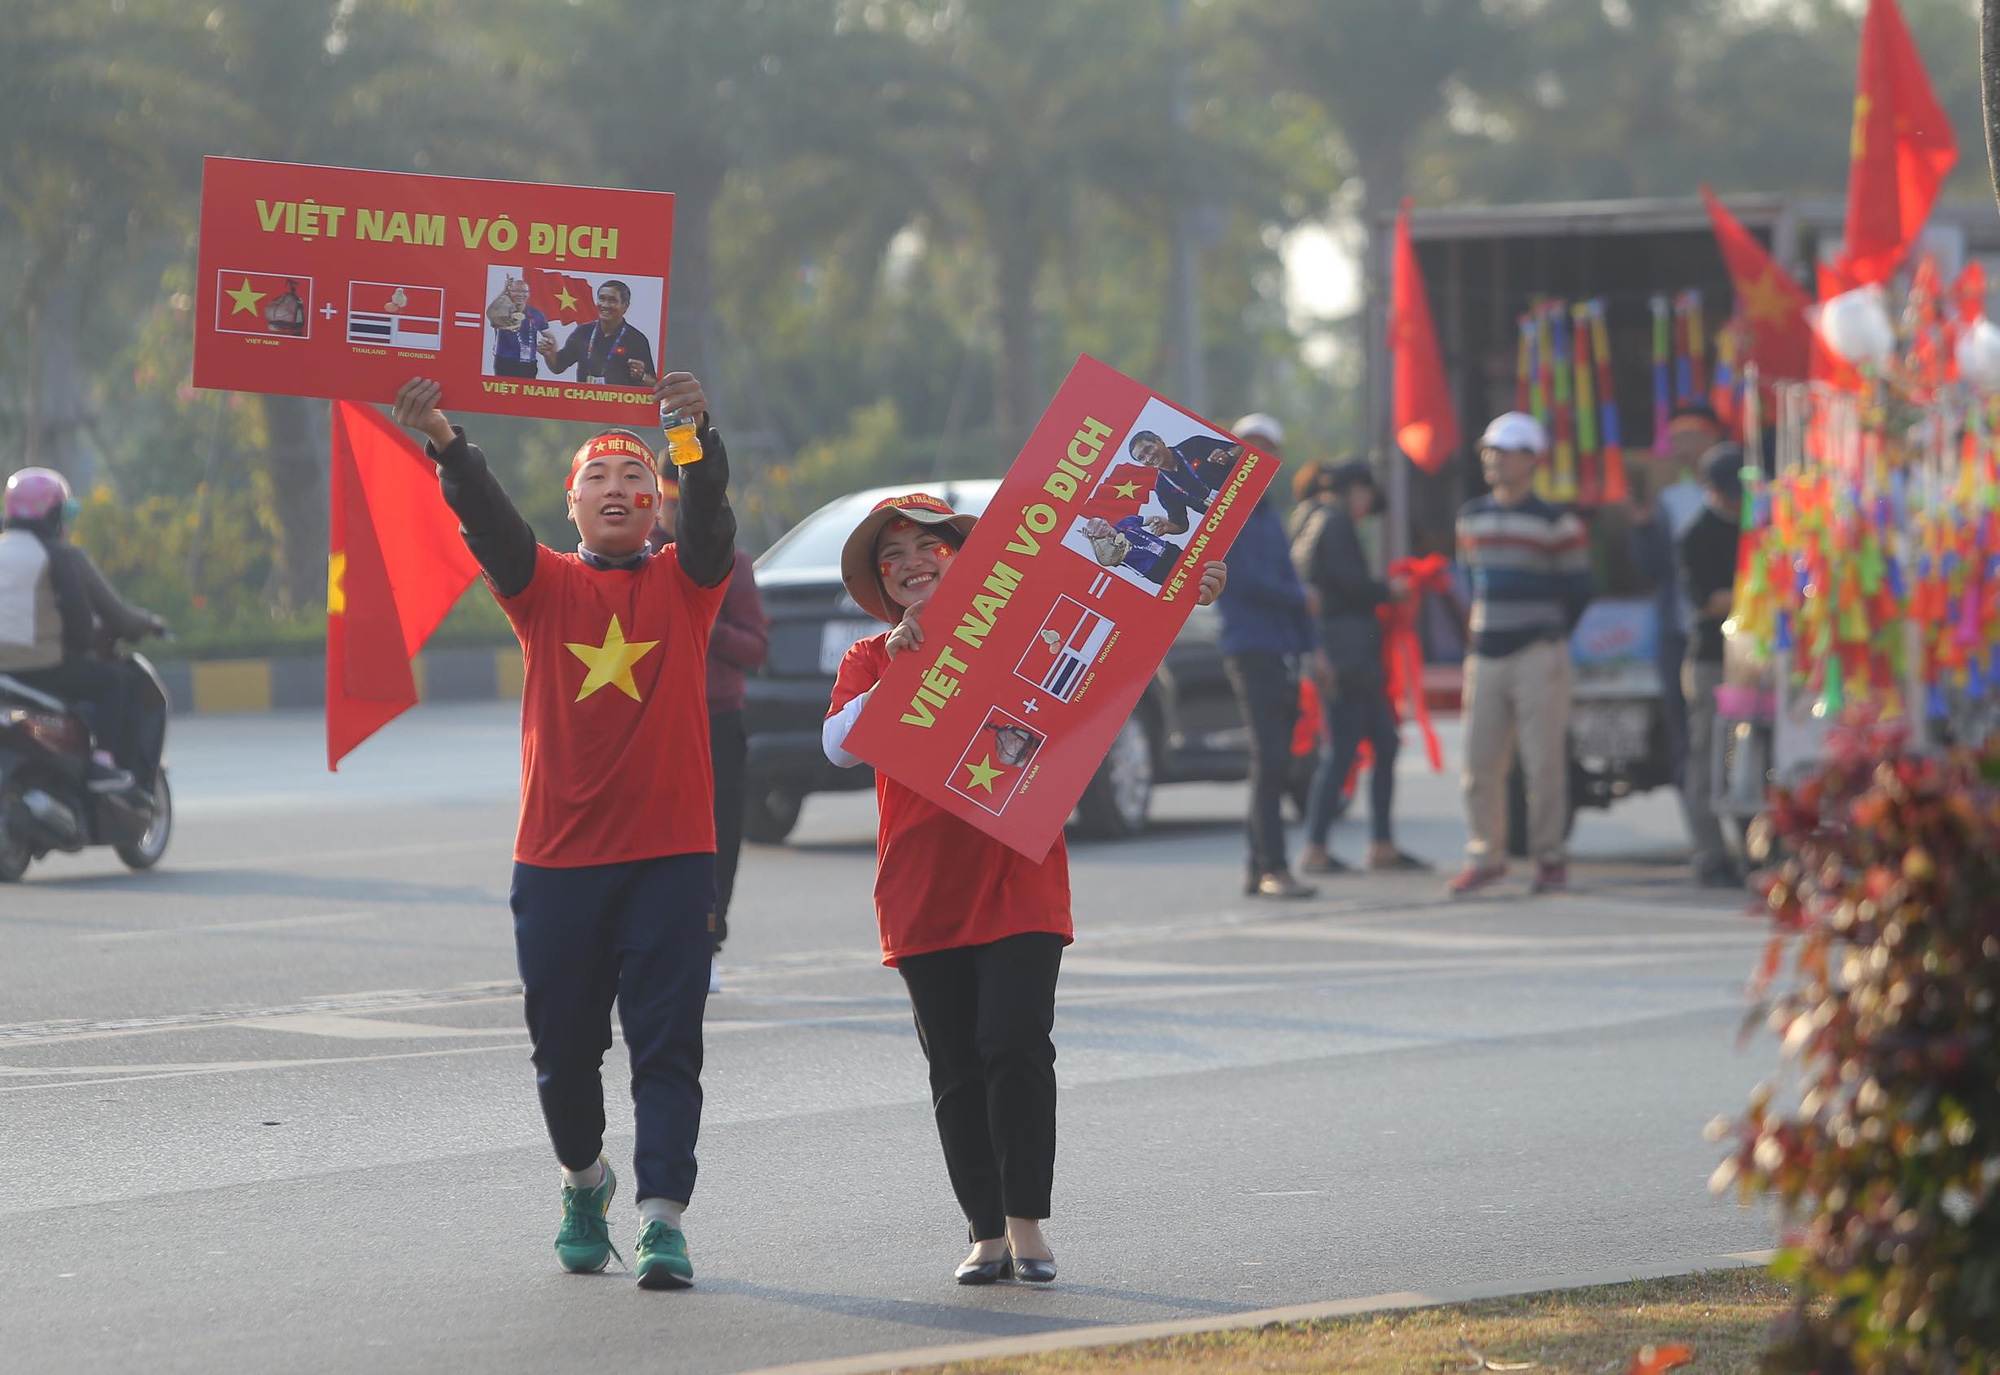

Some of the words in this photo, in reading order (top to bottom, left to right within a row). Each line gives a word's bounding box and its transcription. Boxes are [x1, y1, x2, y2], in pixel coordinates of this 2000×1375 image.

[255, 199, 346, 242] VIỆT
[356, 208, 446, 246] NAM
[458, 214, 518, 252] VÔ
[528, 222, 619, 262] ĐỊCH
[351, 347, 387, 356] THAILAND
[397, 351, 436, 360] INDONESIA
[482, 381, 519, 395] VIỆT
[523, 385, 560, 398] NAM
[563, 388, 654, 405] CHAMPIONS
[607, 437, 624, 451] VIỆT
[625, 440, 641, 455] NAM
[1161, 568, 1189, 602] VIỆT
[1184, 533, 1210, 569] NAM
[1205, 453, 1260, 534] CHAMPIONS
[900, 645, 969, 729] VIỆT
[953, 560, 1024, 649] NAM
[1005, 503, 1058, 557] VÔ
[1042, 416, 1113, 503] ĐỊCH
[1074, 672, 1096, 703] THAILAND
[1097, 630, 1121, 664] INDONESIA
[1028, 764, 1040, 780] NAM
